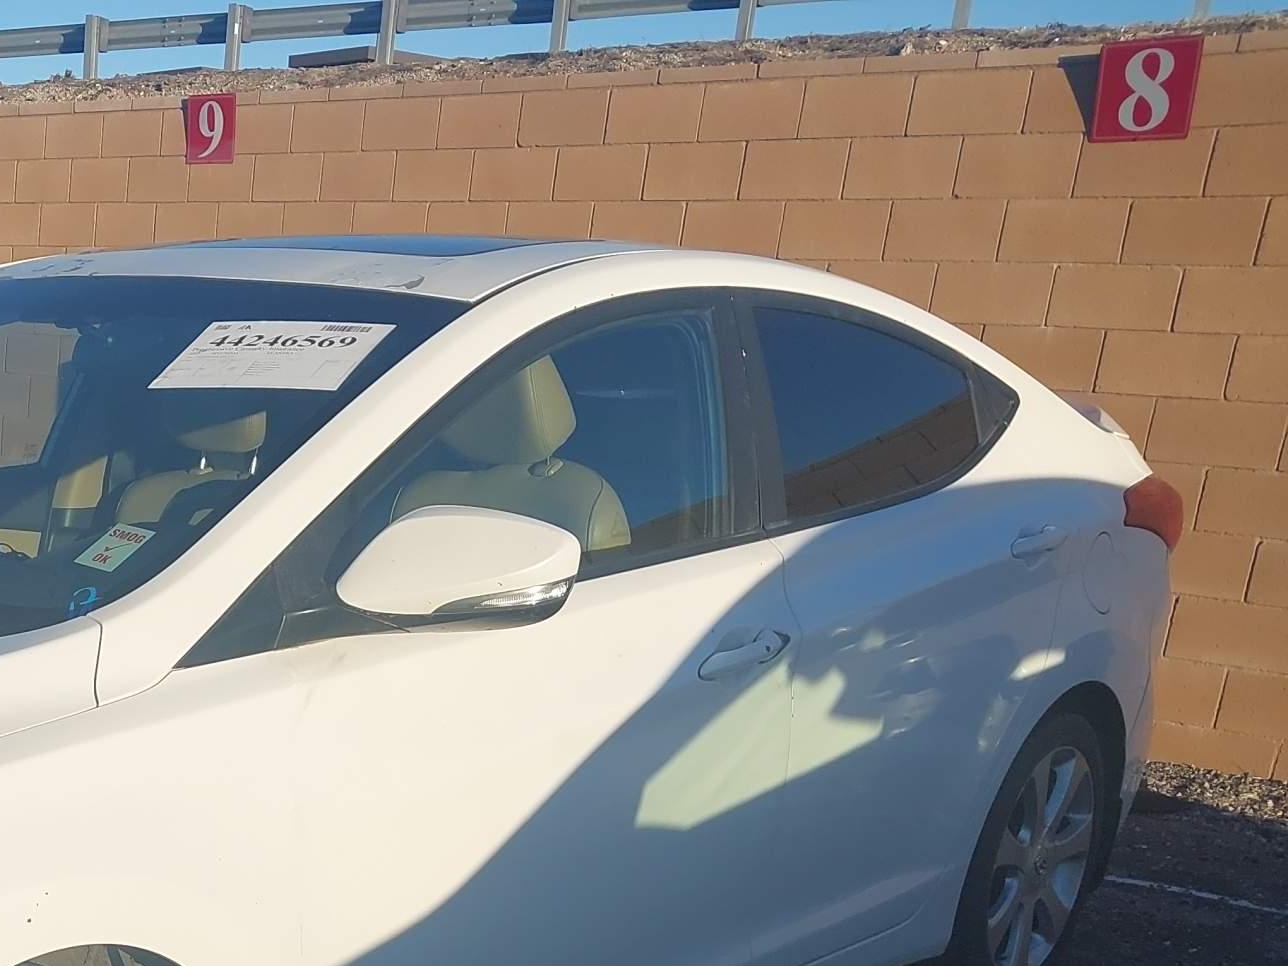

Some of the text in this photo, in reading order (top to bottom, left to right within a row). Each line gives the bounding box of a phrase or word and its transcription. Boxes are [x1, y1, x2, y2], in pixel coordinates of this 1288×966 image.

[1118, 47, 1175, 132] 8
[197, 100, 224, 158] 9
[209, 334, 358, 348] 44246569
[109, 528, 146, 544] SMOG
[92, 553, 112, 565] OK
